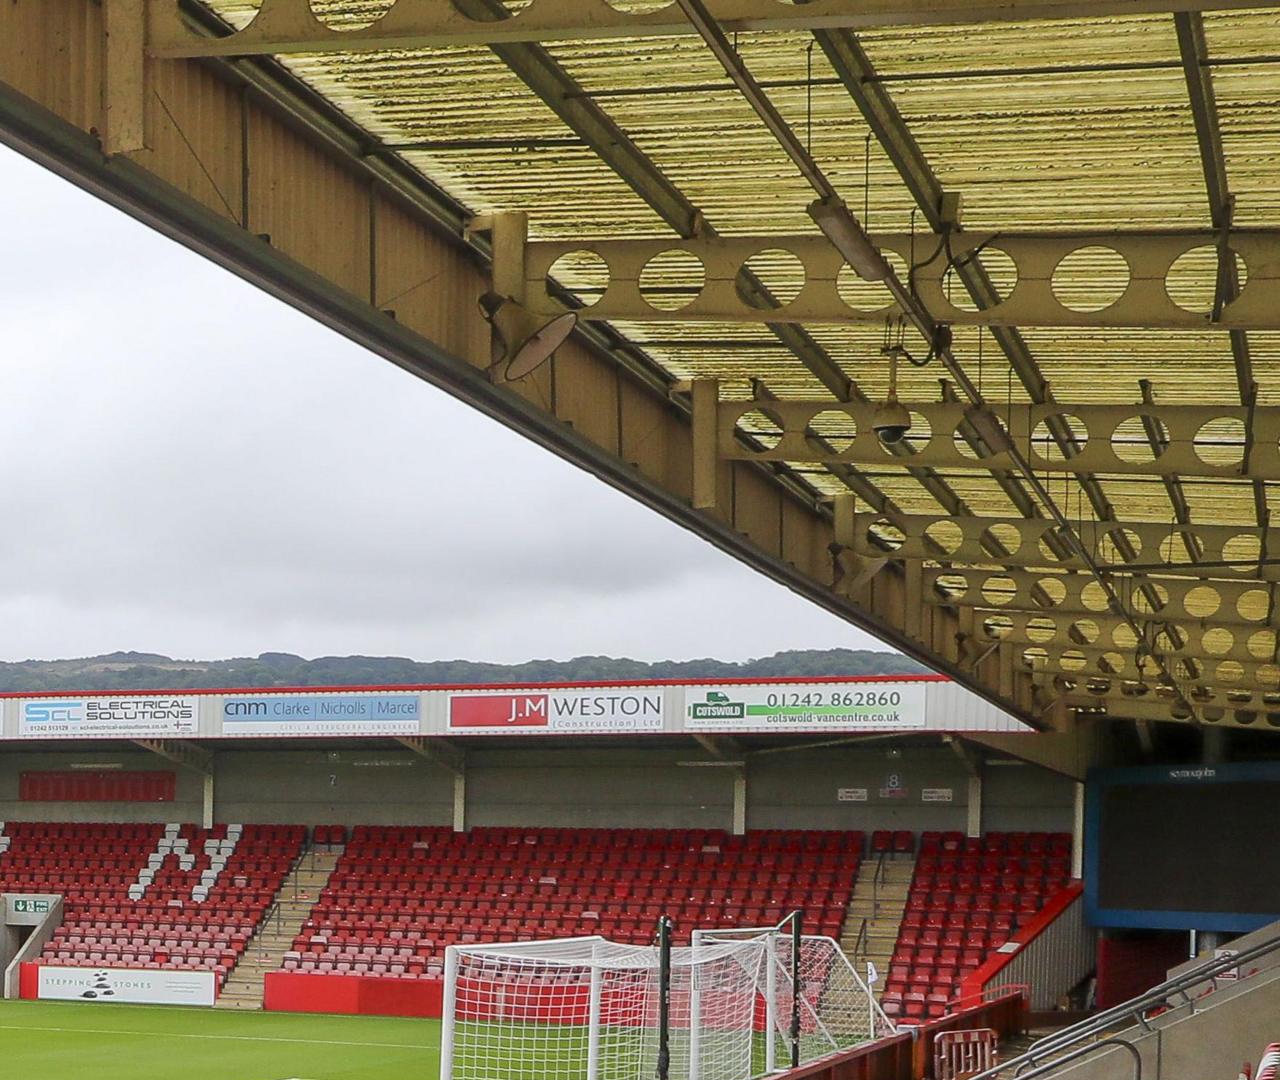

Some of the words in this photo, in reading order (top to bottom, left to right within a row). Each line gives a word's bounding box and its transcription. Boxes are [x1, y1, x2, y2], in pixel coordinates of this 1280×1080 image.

[86, 700, 193, 711] ELECTRICAL
[767, 693, 823, 708] 01242
[830, 691, 901, 707] 862860
[224, 702, 267, 716] cnm
[273, 702, 310, 715] Clarke
[320, 701, 366, 714] Nicholls
[377, 700, 418, 714] Marcel
[507, 698, 545, 722] J.M
[553, 696, 661, 716] WESTON
[696, 706, 741, 717] COTSWOLD
[86, 710, 193, 721] SOLUTIONS
[766, 711, 901, 723] cotswold-vancentre.co.uk
[552, 720, 637, 729] (Construction)
[643, 719, 661, 727] Ltd
[889, 774, 898, 787] 8
